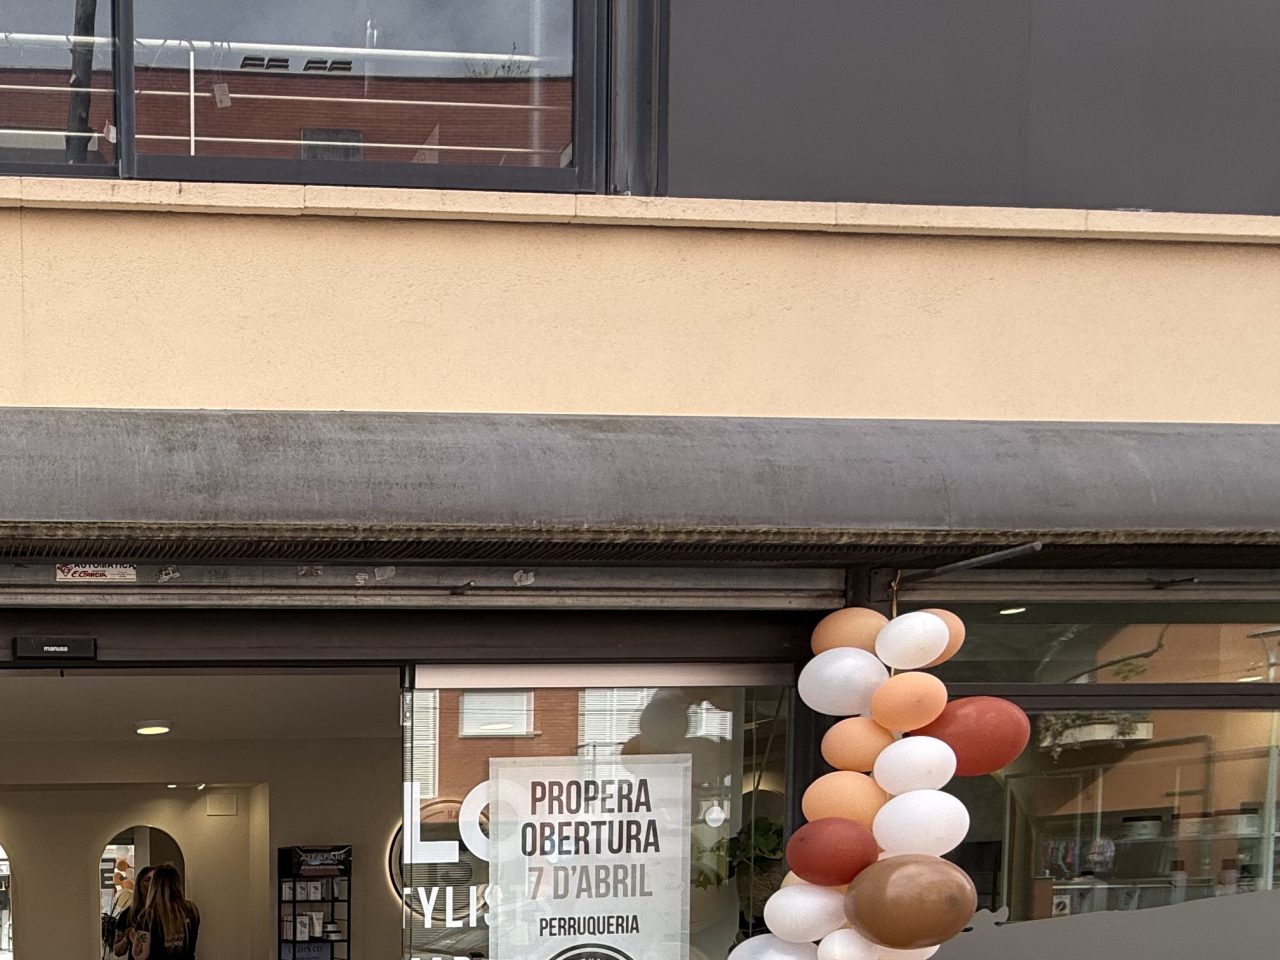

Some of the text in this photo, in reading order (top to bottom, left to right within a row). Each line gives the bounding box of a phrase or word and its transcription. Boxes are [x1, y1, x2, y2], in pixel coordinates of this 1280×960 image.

[531, 778, 652, 815] PROPERA
[521, 819, 660, 857] OBERTURA
[528, 864, 653, 900] 7 D'ABRIL
[540, 915, 640, 936] PERRUQUERIA
